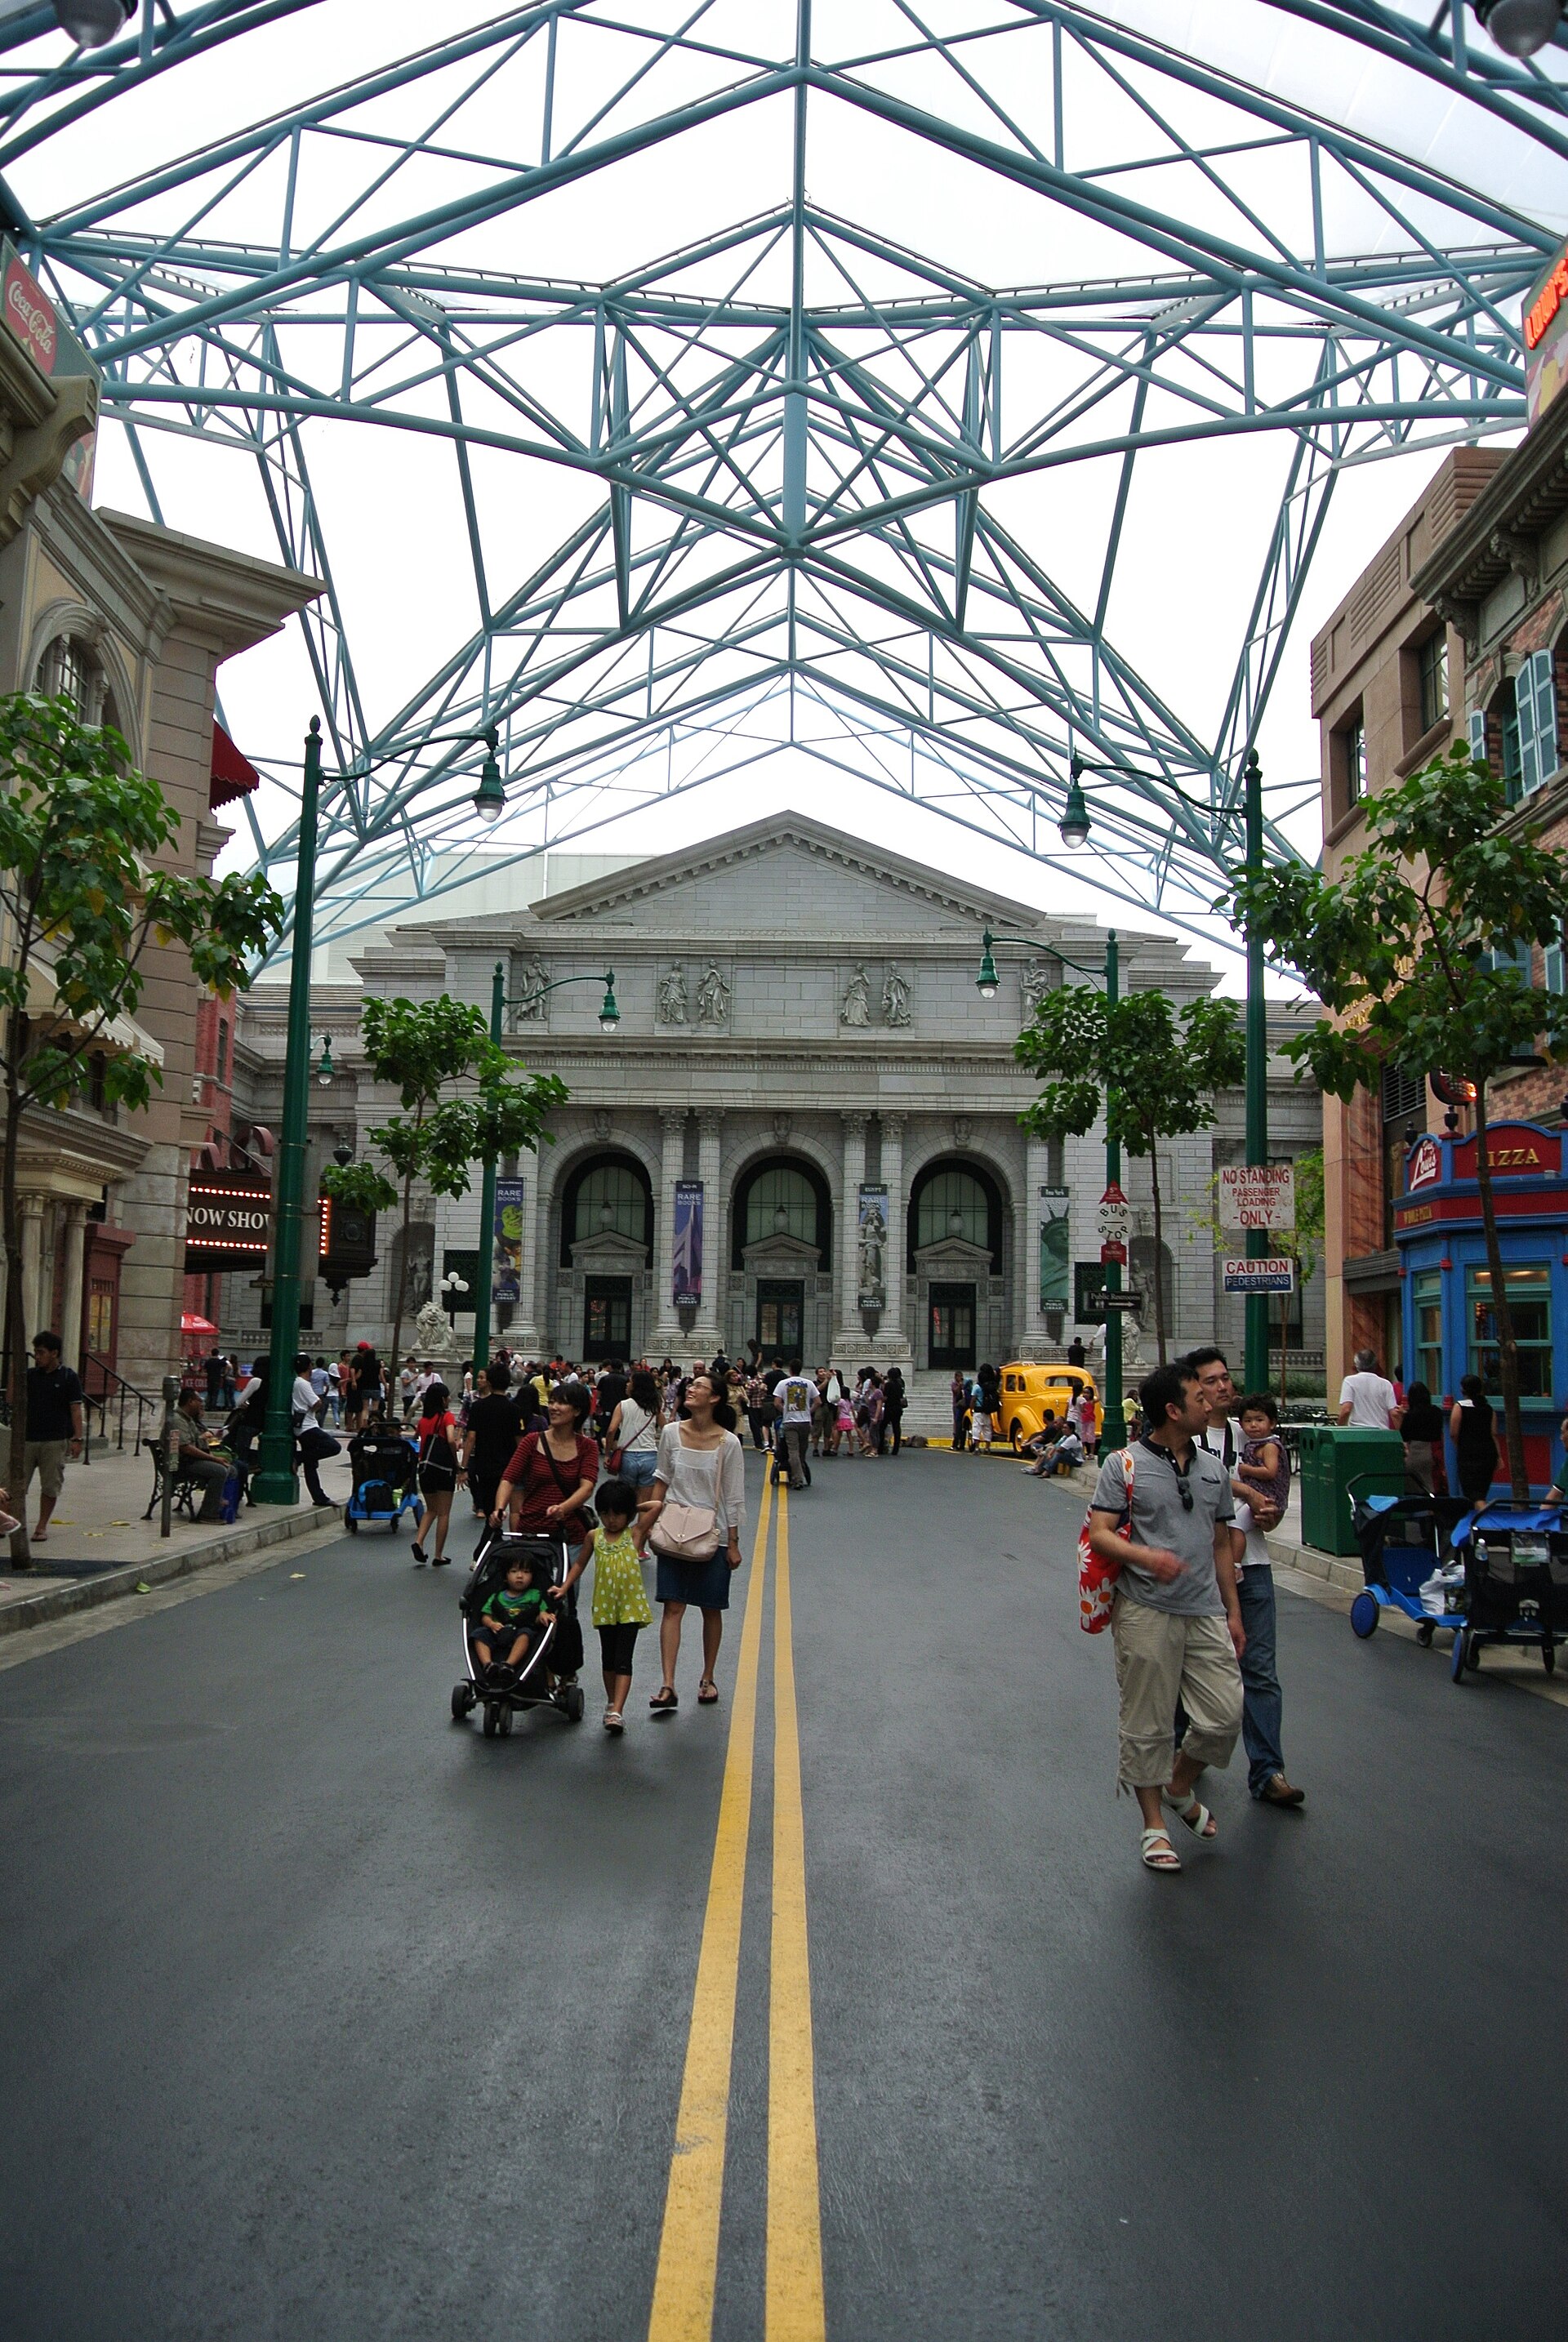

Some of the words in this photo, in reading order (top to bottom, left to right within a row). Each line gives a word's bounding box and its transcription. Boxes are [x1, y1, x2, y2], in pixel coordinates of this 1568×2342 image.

[1475, 1148, 1539, 1168] IZZA
[1223, 1169, 1237, 1184] NO
[1239, 1169, 1290, 1184] STANDING
[1232, 1187, 1281, 1196] PASSENGER
[1236, 1197, 1276, 1207] LOADING
[187, 1207, 225, 1226] NOW
[1099, 1204, 1128, 1218] BUS
[1098, 1225, 1129, 1240] STOP
[1226, 1260, 1288, 1274] CAUTION
[1226, 1276, 1290, 1286] PEDESTRIANS
